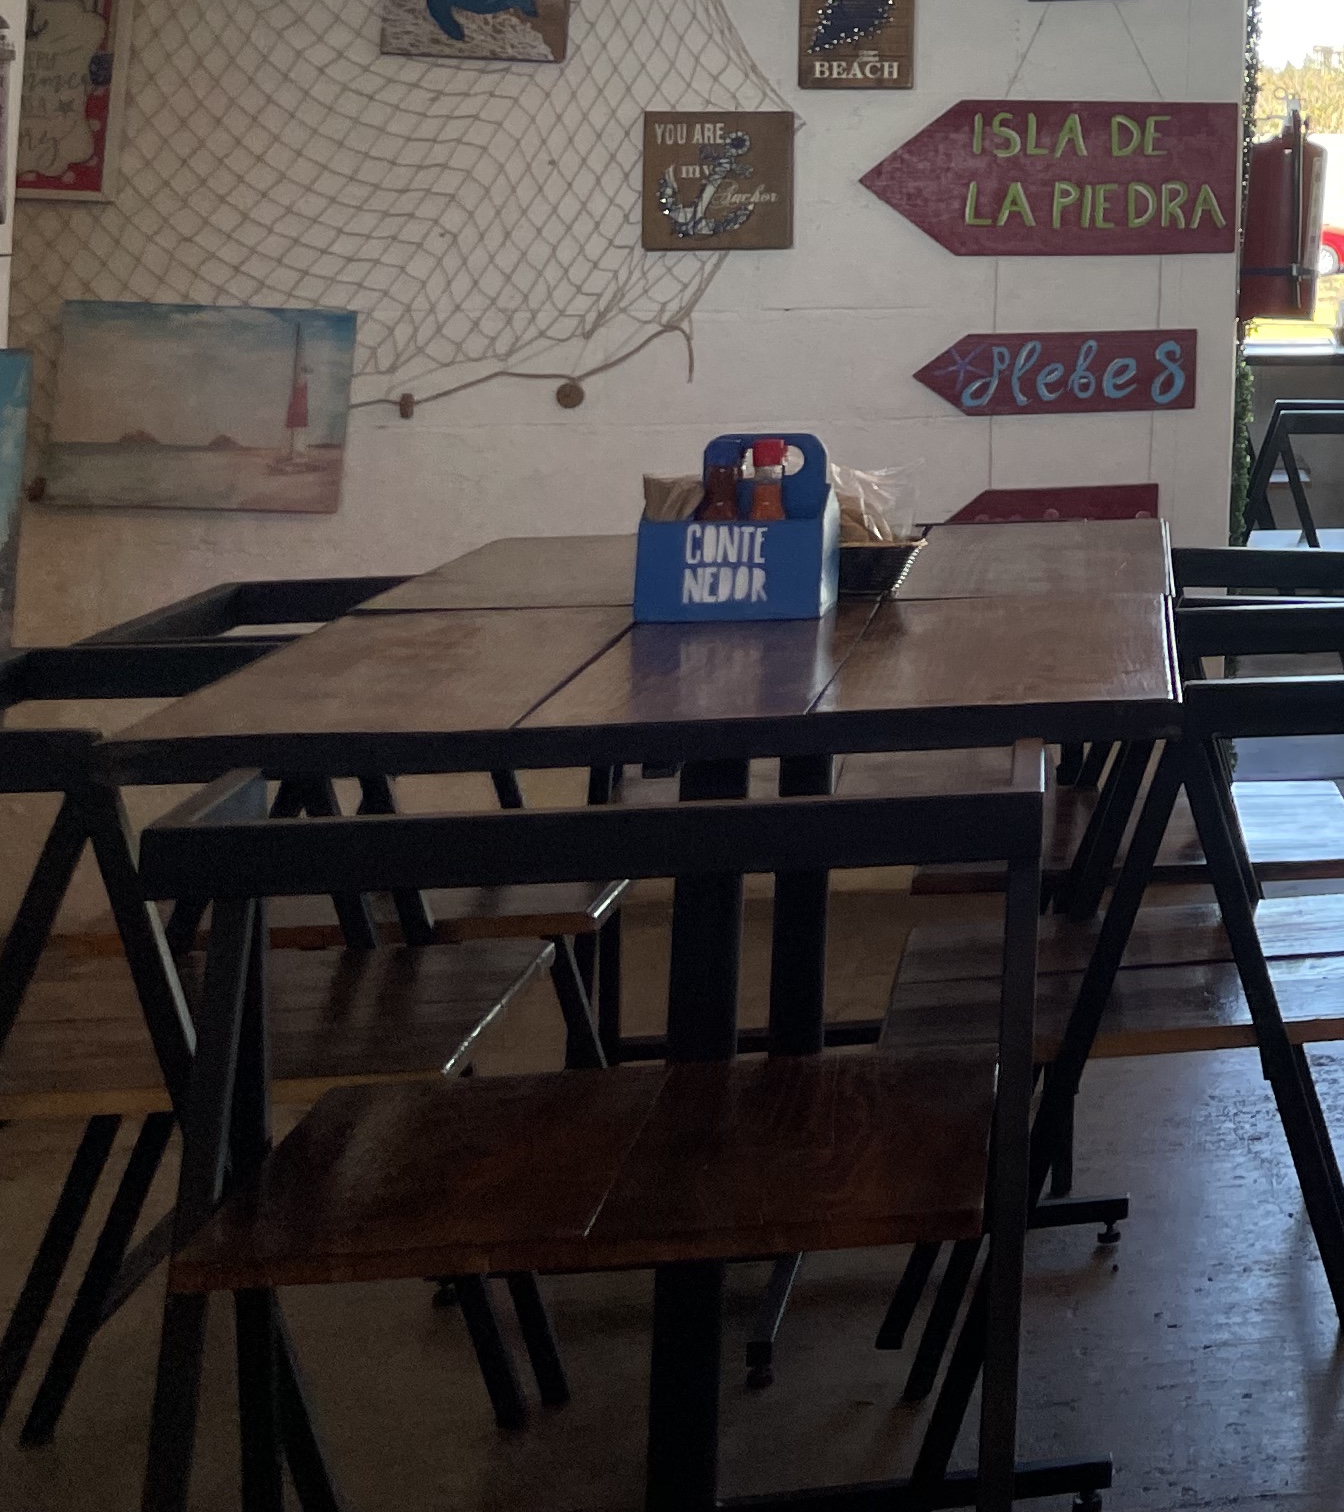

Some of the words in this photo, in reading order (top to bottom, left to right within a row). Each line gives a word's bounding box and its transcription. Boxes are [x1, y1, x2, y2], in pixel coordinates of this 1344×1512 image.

[813, 60, 899, 79] BEACH
[654, 122, 687, 145] YOU
[691, 123, 725, 144] ARE
[972, 112, 1088, 158] ISLA
[1111, 114, 1172, 157] DE
[965, 180, 1037, 227] LA
[1052, 180, 1226, 229] PIEDRA
[684, 523, 769, 565] CONTE
[682, 566, 768, 604] NEDOR
